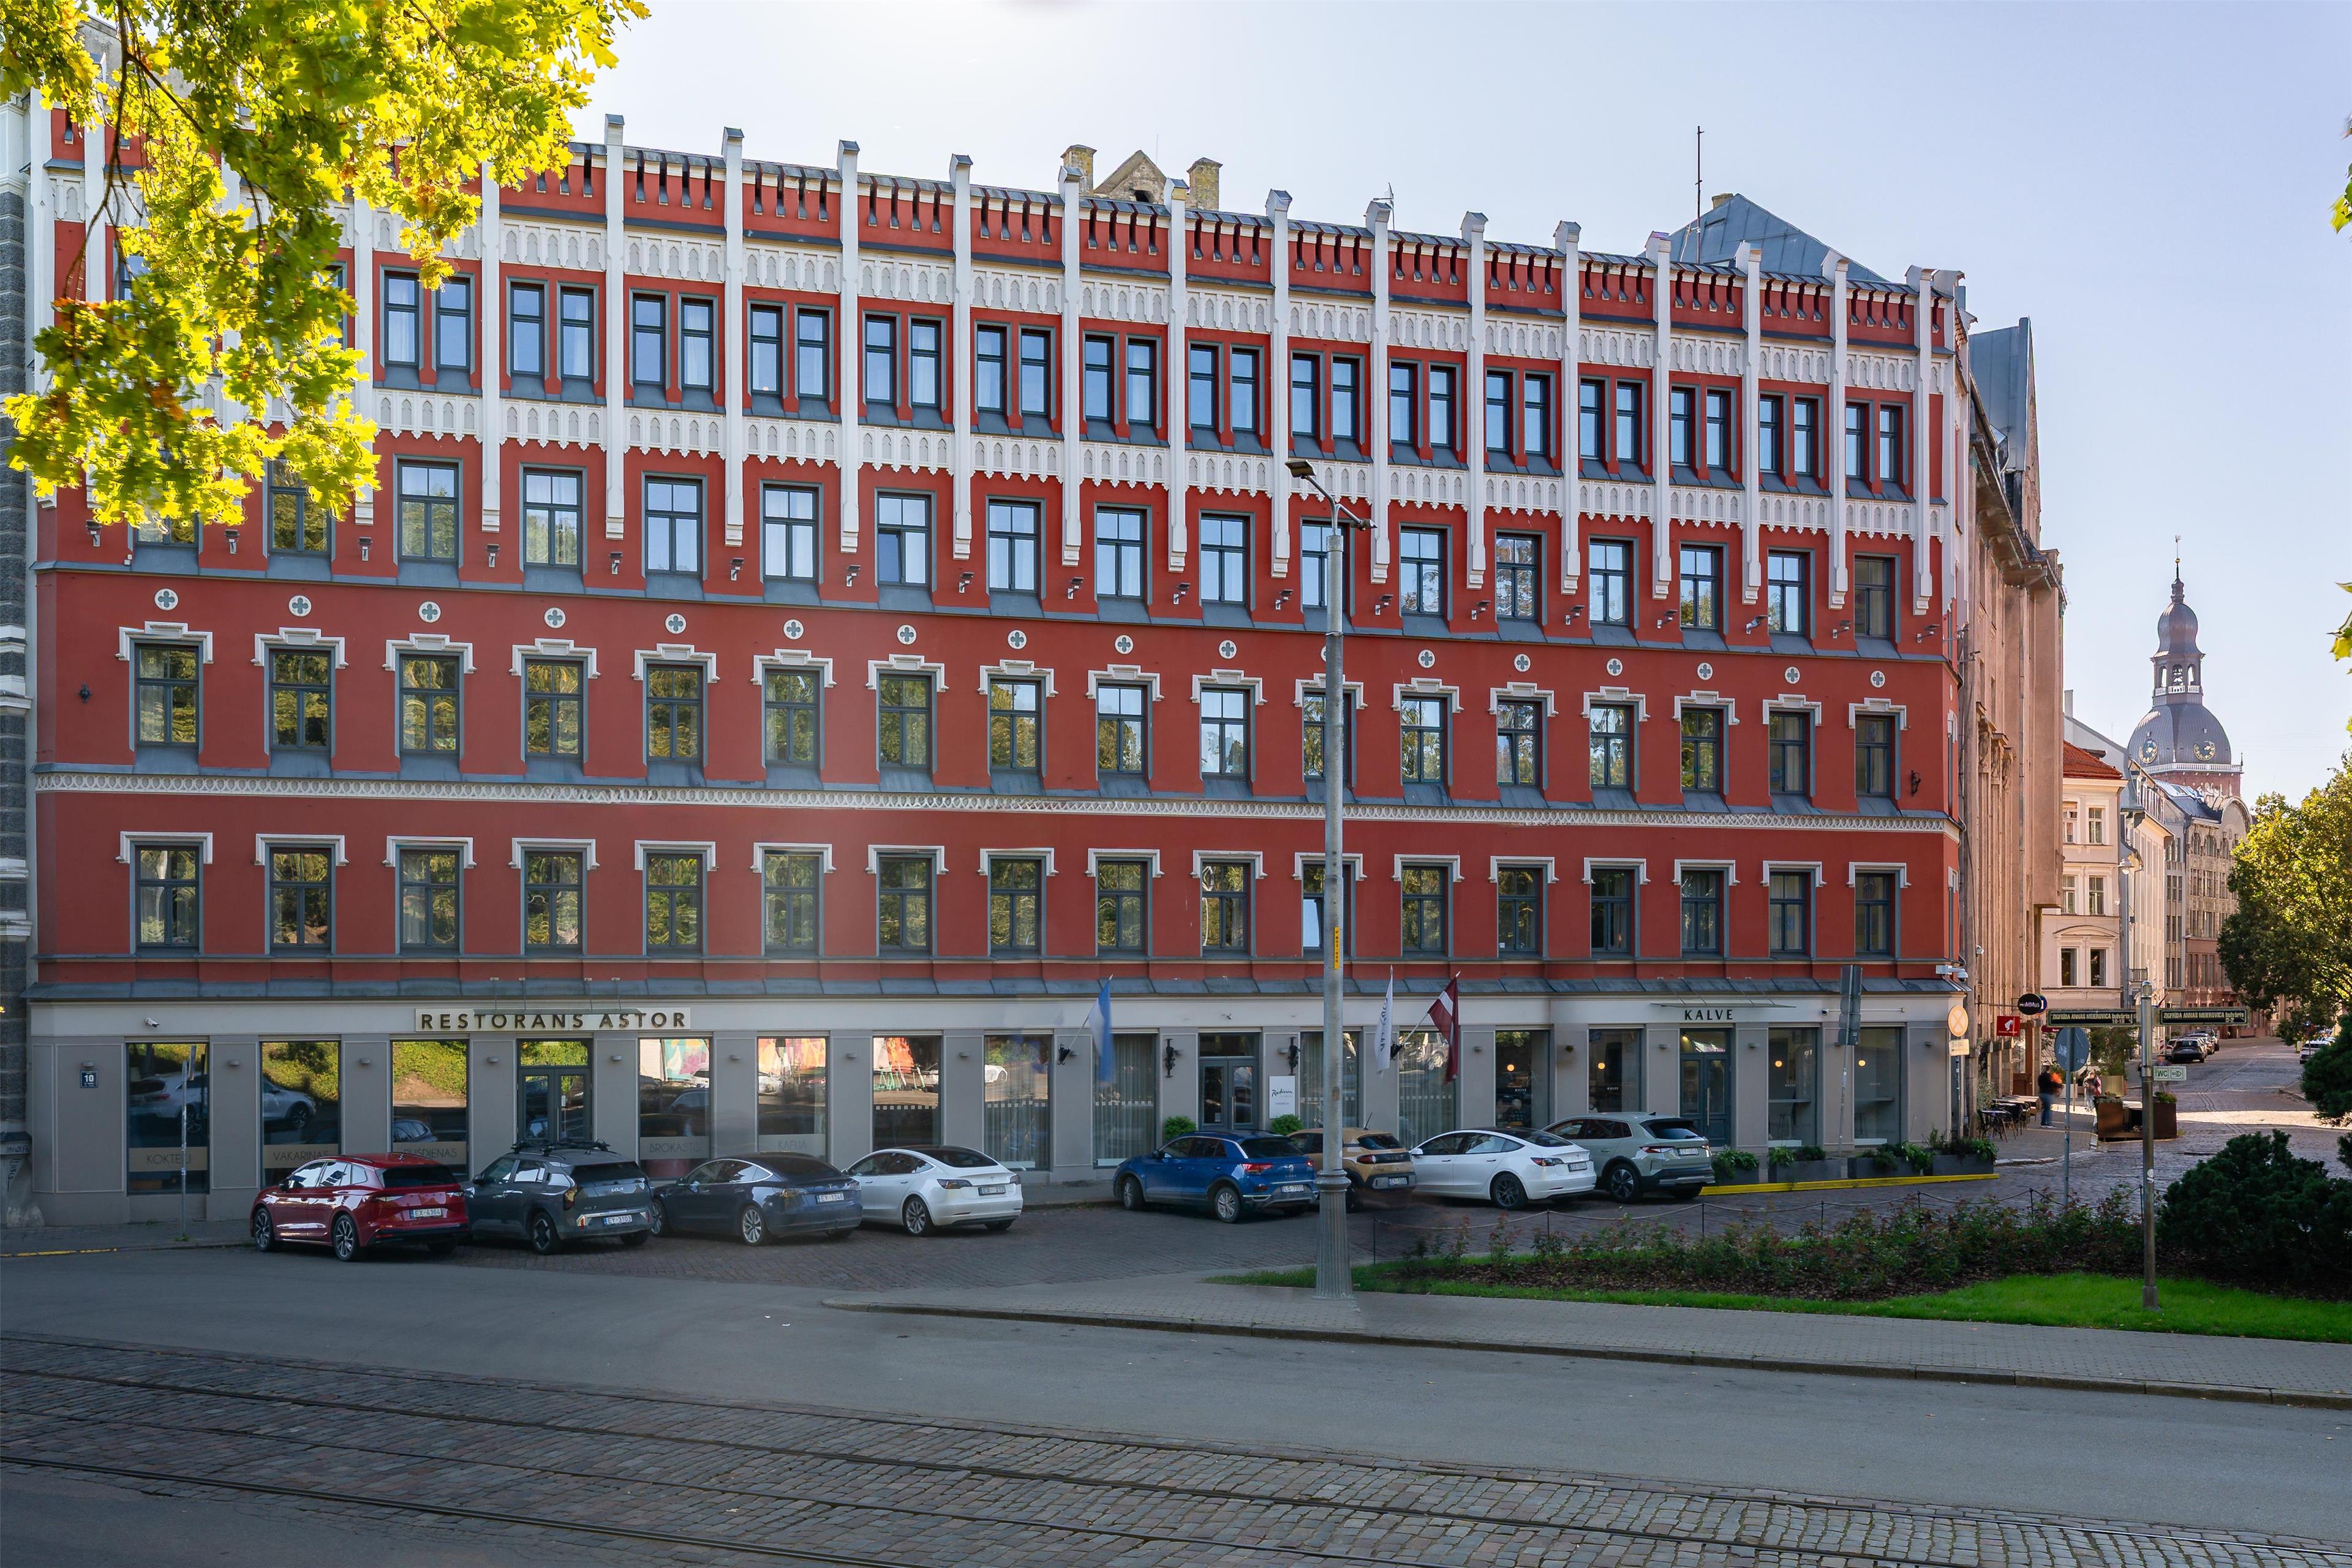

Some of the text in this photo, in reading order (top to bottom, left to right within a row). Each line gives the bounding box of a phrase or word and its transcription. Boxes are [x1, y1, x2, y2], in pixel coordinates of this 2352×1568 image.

[1684, 1009, 1733, 1020] KALVE
[421, 1012, 685, 1029] RESTORANS ASTOR
[147, 1154, 192, 1164] KOKTEI
